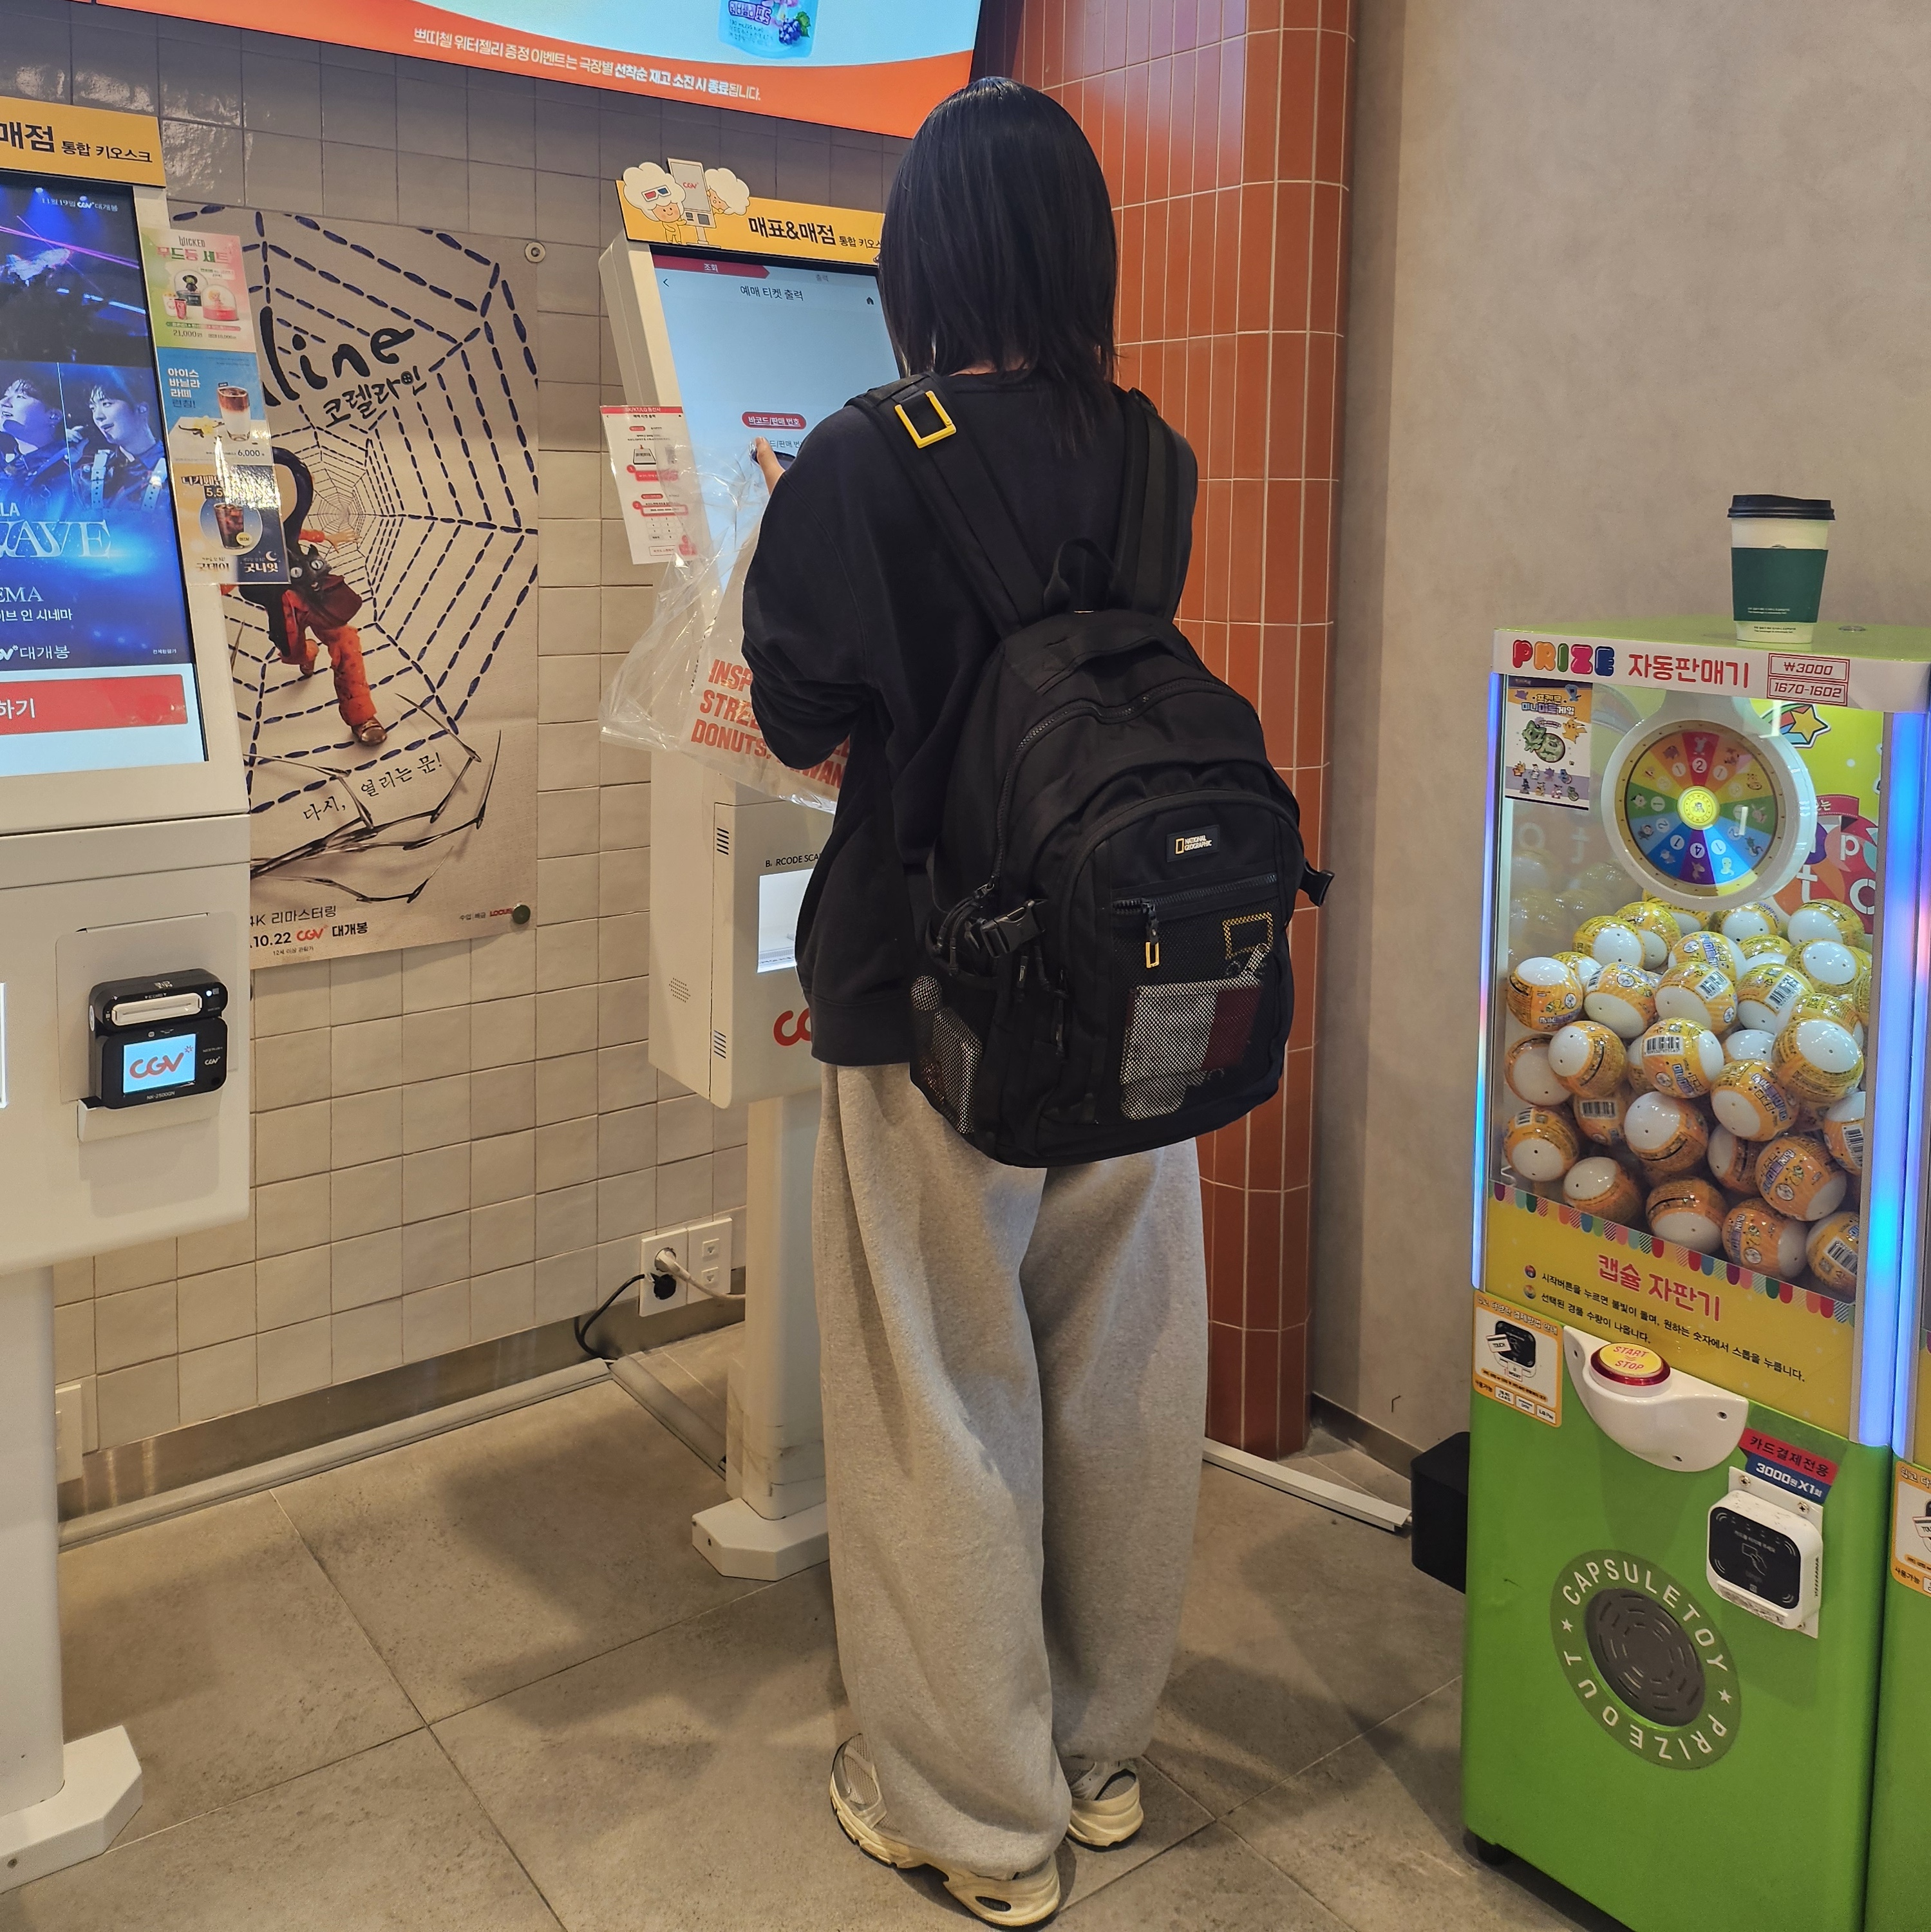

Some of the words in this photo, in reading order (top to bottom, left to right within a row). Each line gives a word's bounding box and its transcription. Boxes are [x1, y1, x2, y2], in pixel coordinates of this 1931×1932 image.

[413, 28, 452, 48] 쁘띠첼
[455, 35, 503, 57] 워터젤리
[505, 44, 529, 61] 증정
[531, 48, 577, 70] 이벤트는
[579, 57, 613, 76] 극장별
[615, 63, 647, 82] 선착순
[649, 69, 671, 86] 재고
[672, 73, 694, 90] 소진
[695, 78, 706, 92] 시
[708, 79, 761, 100] 종료됩니다.
[61, 140, 91, 156] 통합
[96, 146, 153, 162] 키오스크
[748, 216, 836, 245] 매표&매점
[839, 236, 856, 247] 통합
[178, 236, 206, 247] WICKED
[157, 247, 198, 261] 무드등
[704, 263, 719, 273] 조회
[740, 285, 760, 297] 예매
[762, 287, 782, 299] 티켓
[784, 290, 805, 301] 출력
[260, 306, 415, 407] line
[167, 368, 199, 378] 아이스
[169, 378, 201, 388] 바닐라
[171, 389, 191, 399] 라떼
[748, 417, 786, 426] 바코드/판매
[786, 418, 801, 426] 번호
[244, 562, 279, 573] 굿나잇
[21, 609, 33, 621] 인
[36, 608, 73, 621] 시네마
[20, 645, 70, 660] 대개봉
[1512, 639, 1615, 676] PRIZE
[1628, 654, 1749, 688] 자동판매기
[1774, 681, 1842, 698] 1670-1602
[417, 752, 443, 775] 문!
[1696, 760, 1703, 771] 2
[1185, 835, 1207, 844] NATIONAL
[1185, 840, 1212, 851] GEOGRAPHIC
[1695, 846, 1702, 857] 4
[766, 856, 803, 868] BRCODE
[804, 853, 822, 862] SCA
[272, 905, 337, 925] 리마스터링
[296, 927, 324, 942] CGV
[332, 922, 368, 937] 대개봉
[129, 1052, 185, 1079] CGV
[204, 1057, 220, 1066] CGV
[1598, 1254, 1641, 1293] 캡슐
[1648, 1273, 1720, 1322] 자판기
[1541, 1292, 1565, 1310] 선택된
[1568, 1302, 1584, 1318] 경품
[1587, 1310, 1612, 1329] 수량이
[1614, 1322, 1652, 1344] 나옵니다.
[1542, 1273, 1581, 1296] 시작버튼을
[1584, 1288, 1608, 1306] 누르면
[1612, 1299, 1637, 1318] 불빛이
[1664, 1319, 1690, 1338] 원하는
[1693, 1331, 1729, 1353] 숫자에서
[1731, 1347, 1760, 1365] 스톱을
[1763, 1357, 1805, 1383] 누릅니다.
[1613, 1345, 1650, 1358] START
[1614, 1359, 1645, 1371] STOP
[1895, 1566, 1920, 1584] 사용가능
